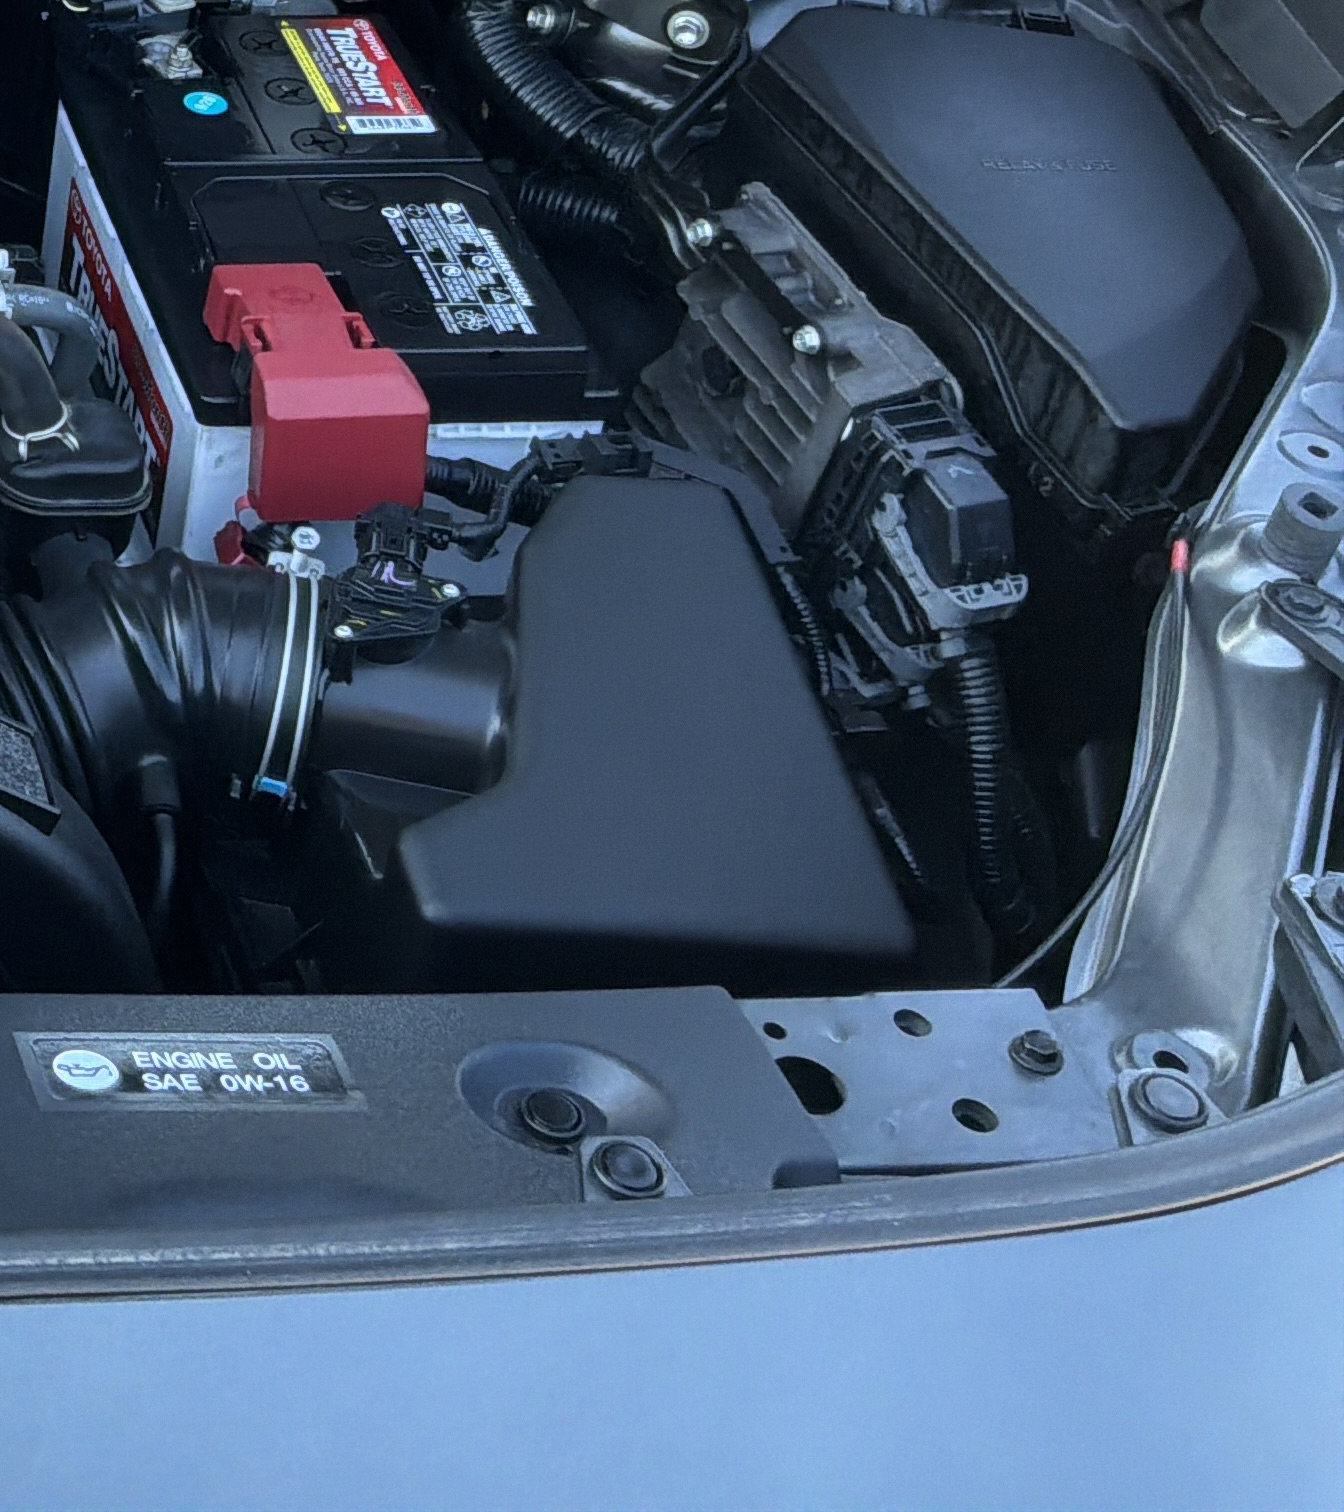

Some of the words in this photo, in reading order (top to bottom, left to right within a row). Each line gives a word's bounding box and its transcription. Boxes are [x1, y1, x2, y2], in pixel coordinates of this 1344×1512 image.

[361, 30, 388, 61] TOYOTA
[81, 221, 113, 303] TOYOTA
[131, 1050, 238, 1070] ENGINE
[252, 1052, 303, 1071] OIL
[141, 1072, 204, 1092] SAE
[219, 1073, 312, 1093] 0W-16
